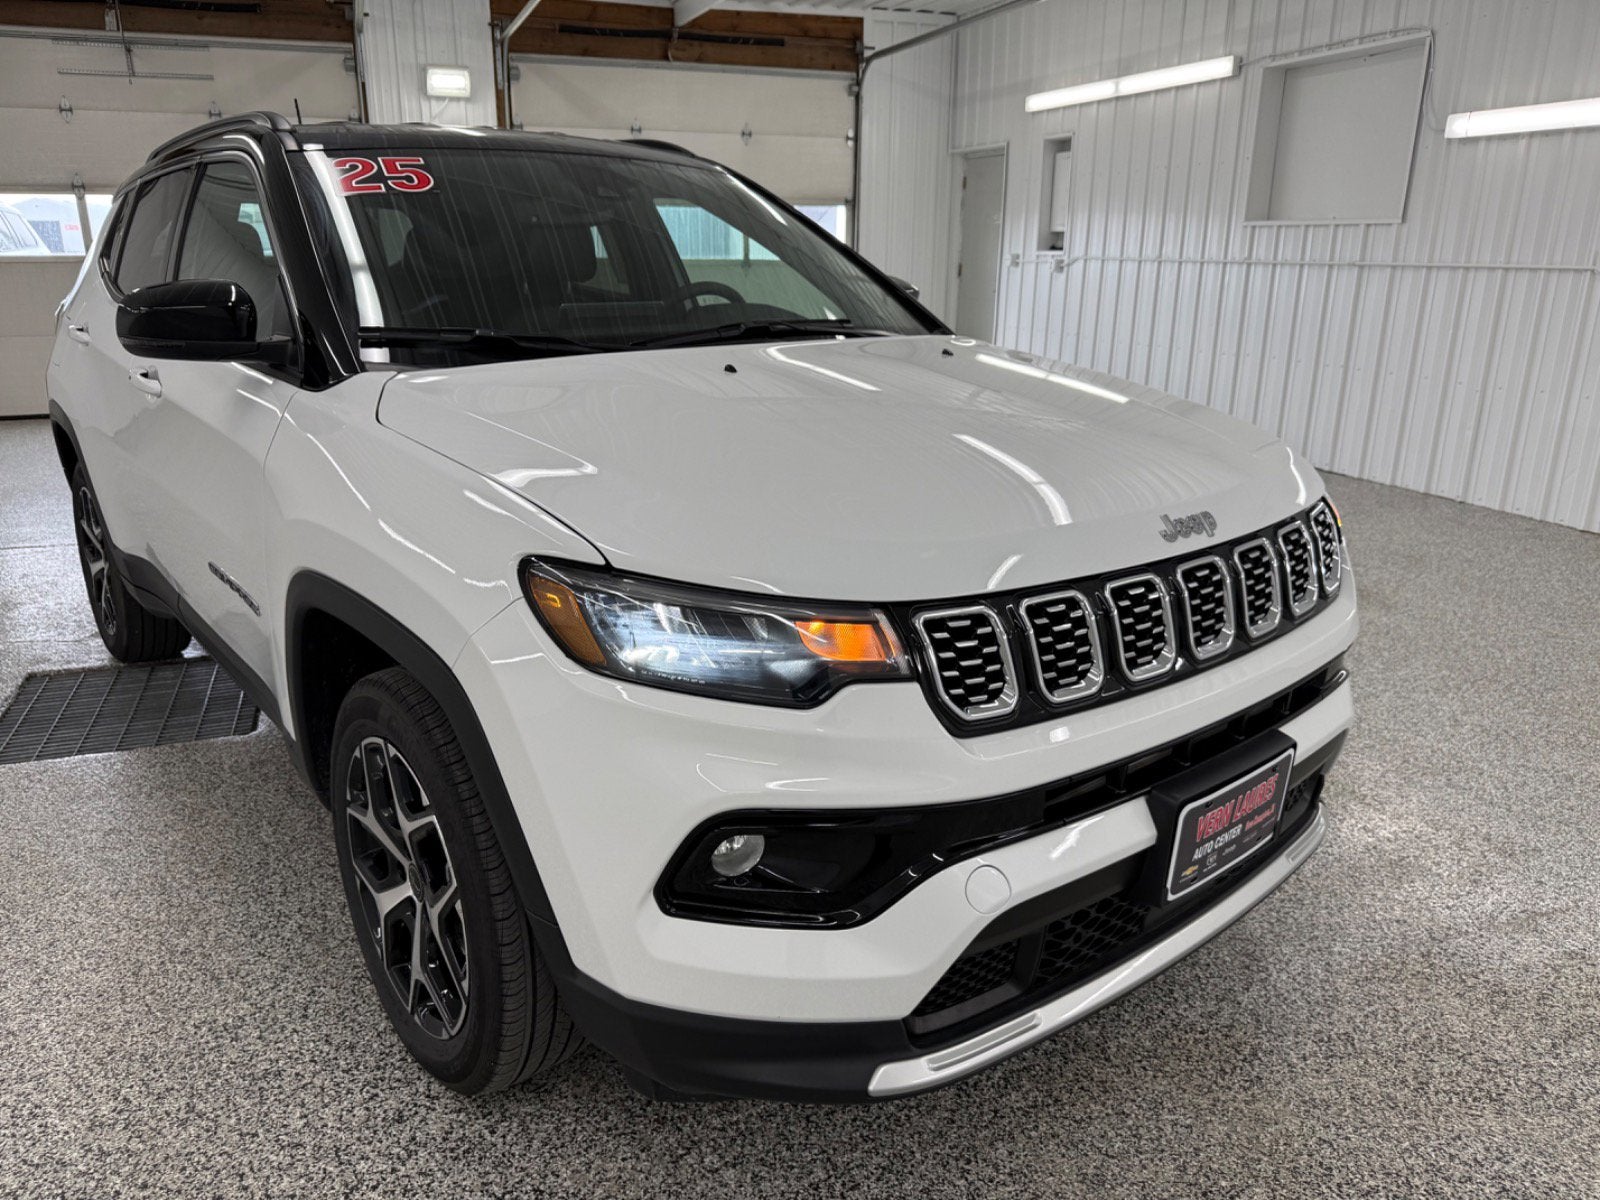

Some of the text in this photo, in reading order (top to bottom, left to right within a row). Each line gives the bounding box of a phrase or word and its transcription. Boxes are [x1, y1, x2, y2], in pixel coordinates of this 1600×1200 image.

[333, 157, 434, 192] 25
[1158, 510, 1217, 543] Jeep
[1196, 799, 1235, 842] VERN
[1191, 840, 1214, 861] AUTO
[1214, 824, 1243, 849] CENTER
